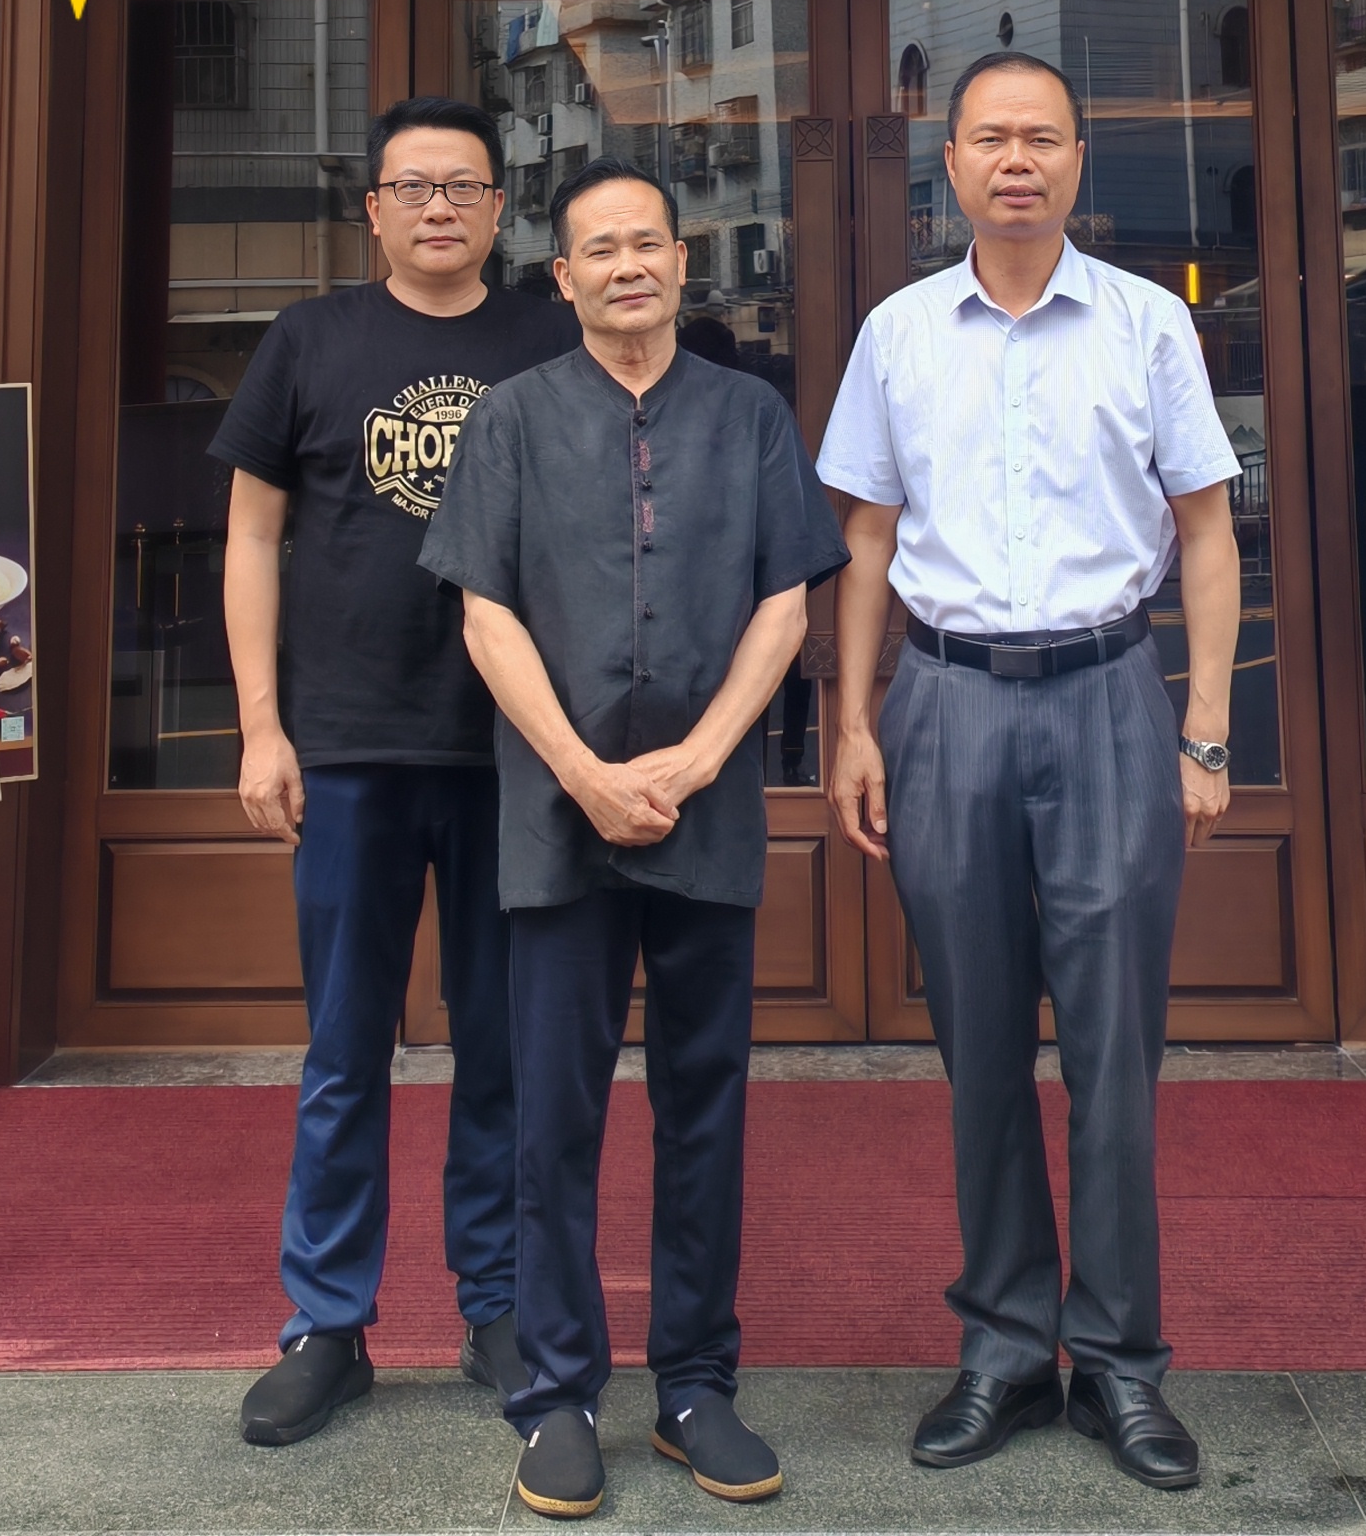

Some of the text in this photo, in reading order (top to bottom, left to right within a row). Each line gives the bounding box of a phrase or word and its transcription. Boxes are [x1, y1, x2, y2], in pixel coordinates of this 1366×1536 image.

[409, 395, 455, 419] EVERY
[435, 410, 462, 420] 1996
[391, 493, 429, 520] MAJOR
